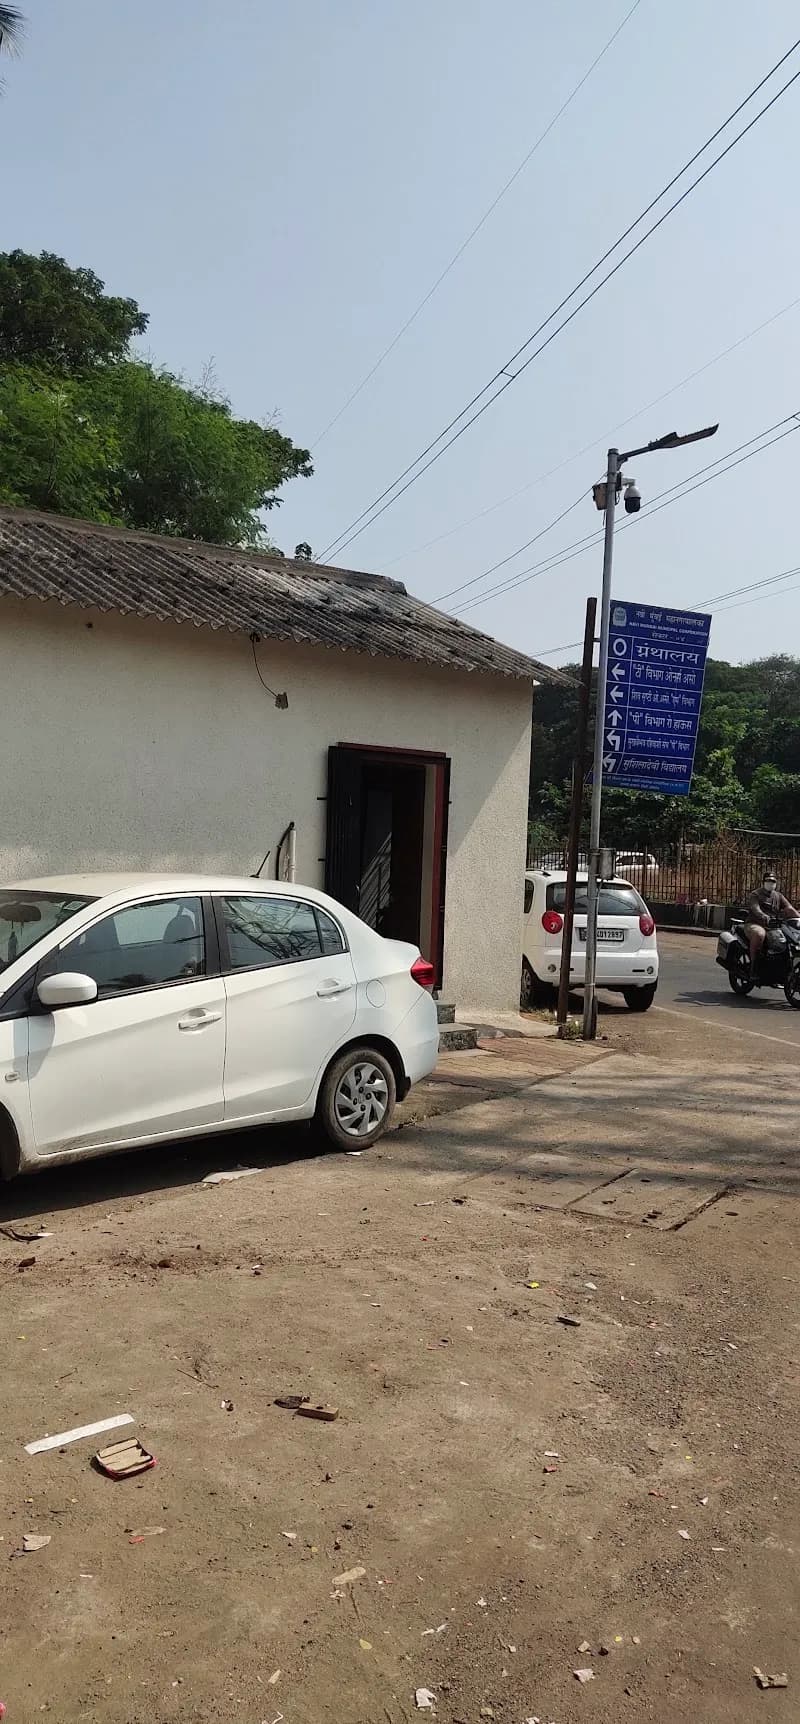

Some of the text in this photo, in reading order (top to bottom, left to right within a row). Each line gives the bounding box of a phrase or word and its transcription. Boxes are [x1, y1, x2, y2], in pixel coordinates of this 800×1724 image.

[679, 628, 708, 636] CORPORATION
[635, 643, 700, 664] ग्रंथालय
[645, 665, 664, 680] विभाग
[644, 713, 665, 728] विभाग
